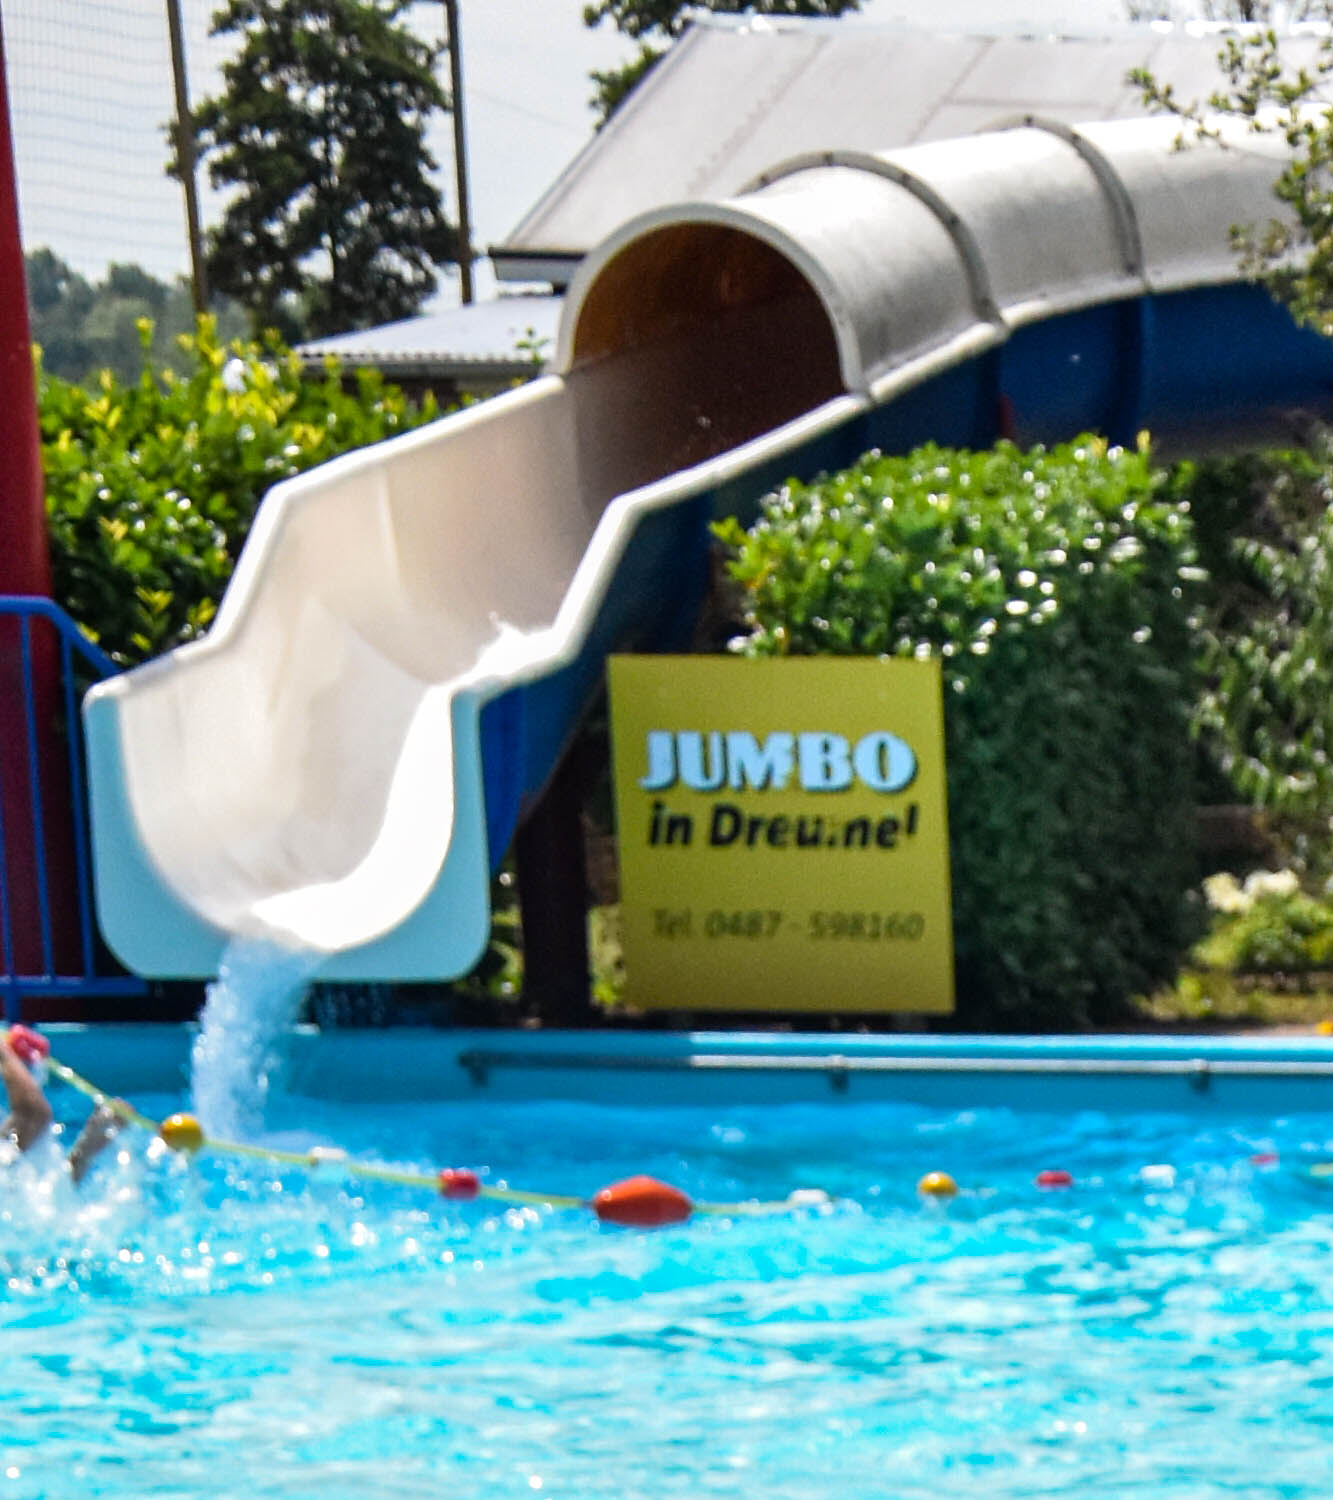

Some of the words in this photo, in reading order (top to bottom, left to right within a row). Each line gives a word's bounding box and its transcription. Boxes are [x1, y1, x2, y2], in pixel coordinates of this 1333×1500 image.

[637, 729, 918, 793] JUMBO
[649, 800, 694, 846] in
[703, 908, 783, 940] 0487
